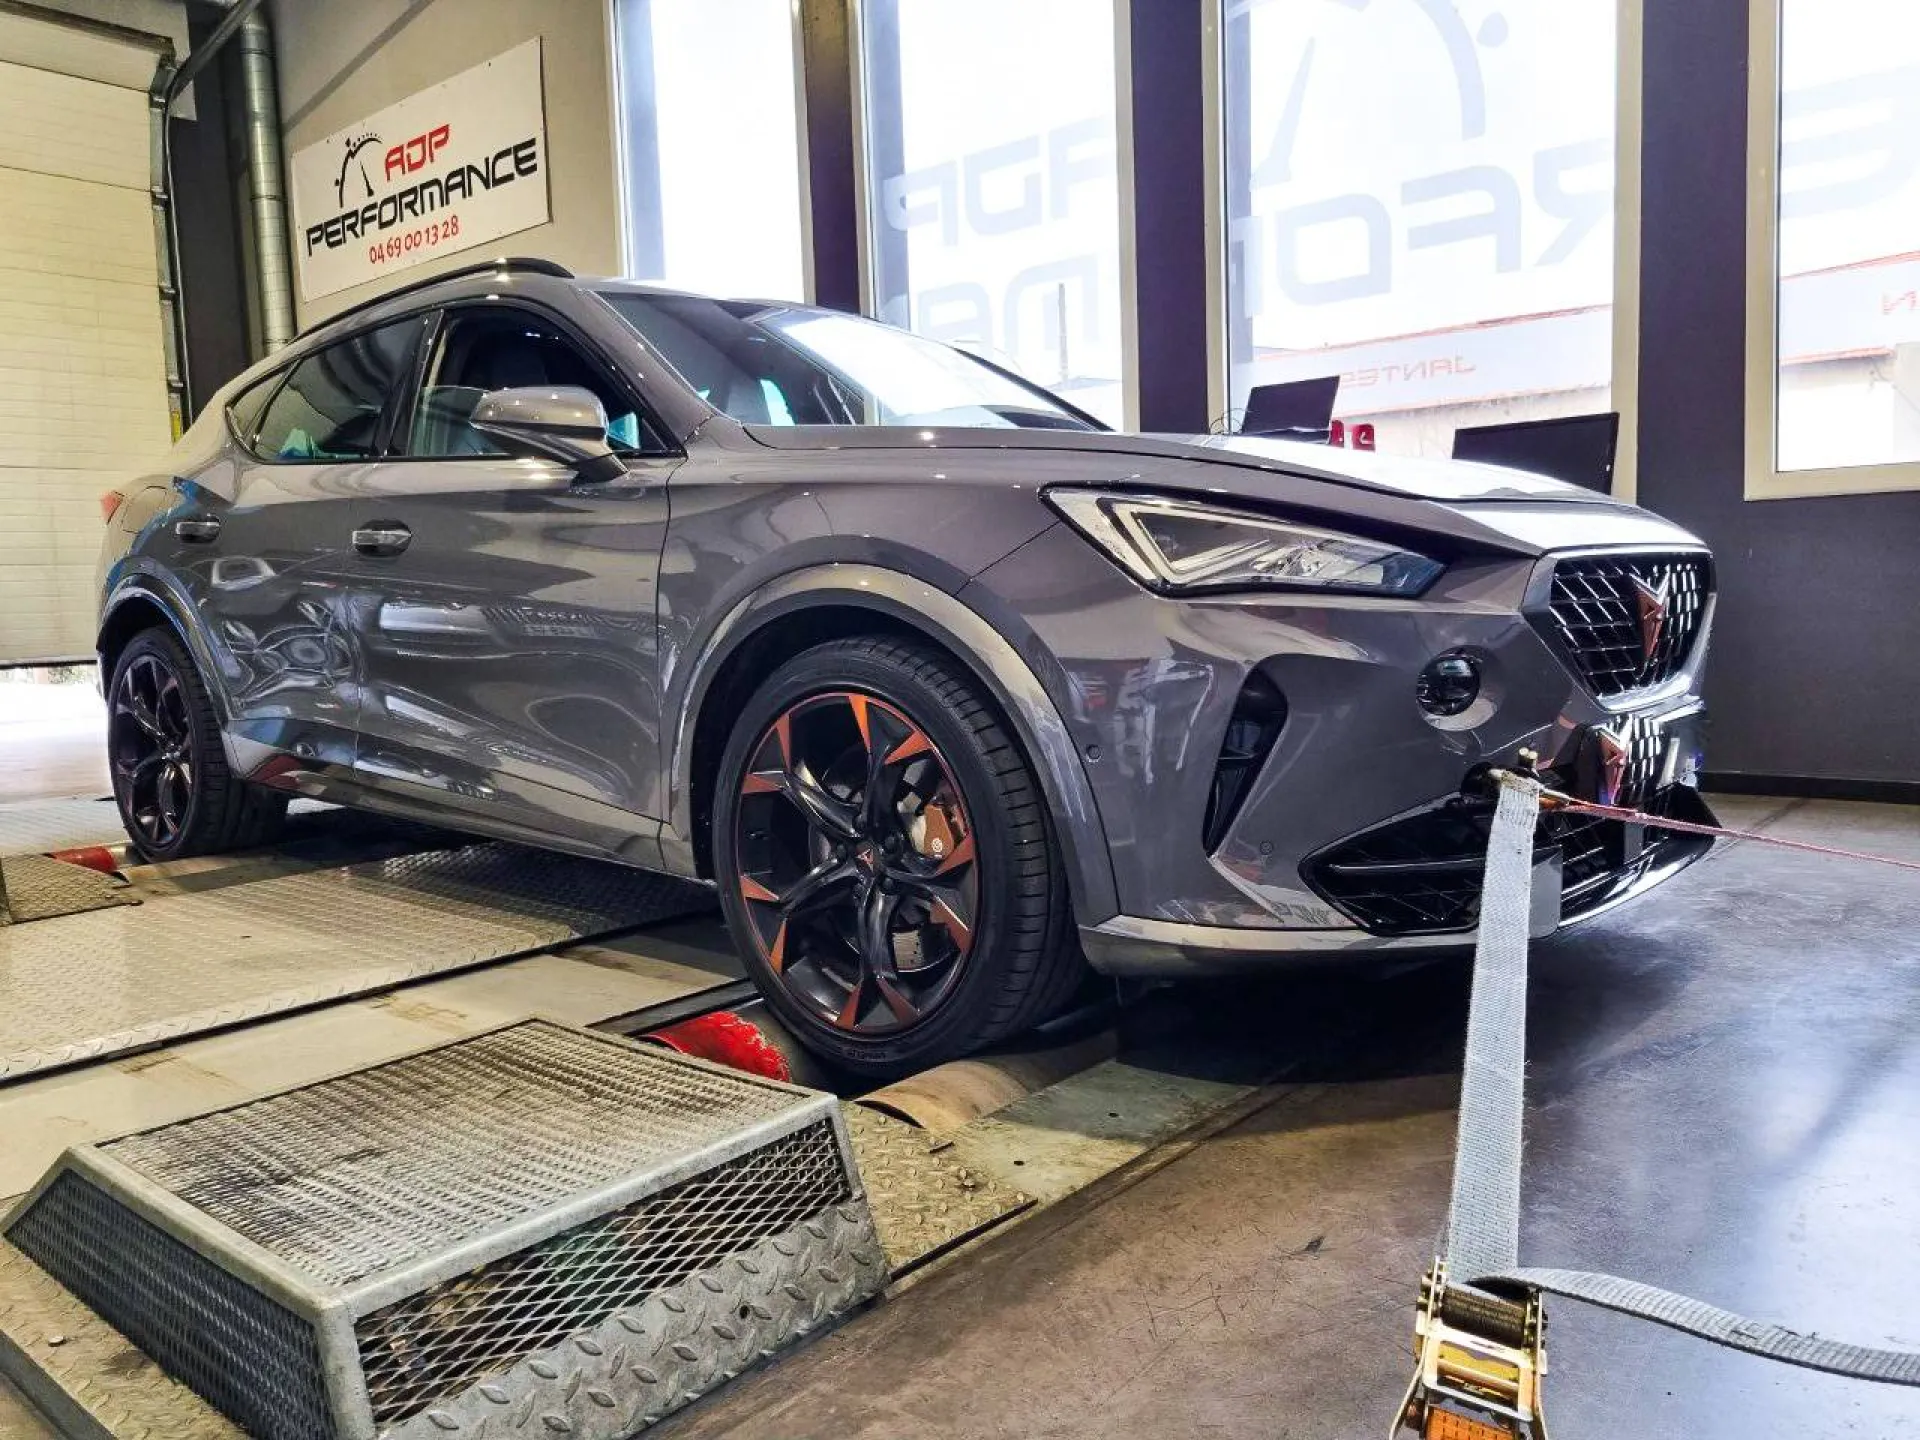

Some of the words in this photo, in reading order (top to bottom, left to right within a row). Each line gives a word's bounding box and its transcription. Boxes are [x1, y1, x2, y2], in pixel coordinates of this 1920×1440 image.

[385, 124, 450, 182] ADP
[306, 138, 537, 257] PERFORMANCE
[369, 244, 385, 265] 04
[386, 237, 402, 258] 69
[404, 231, 423, 249] 00
[425, 224, 439, 246] 13
[442, 215, 460, 239] 28
